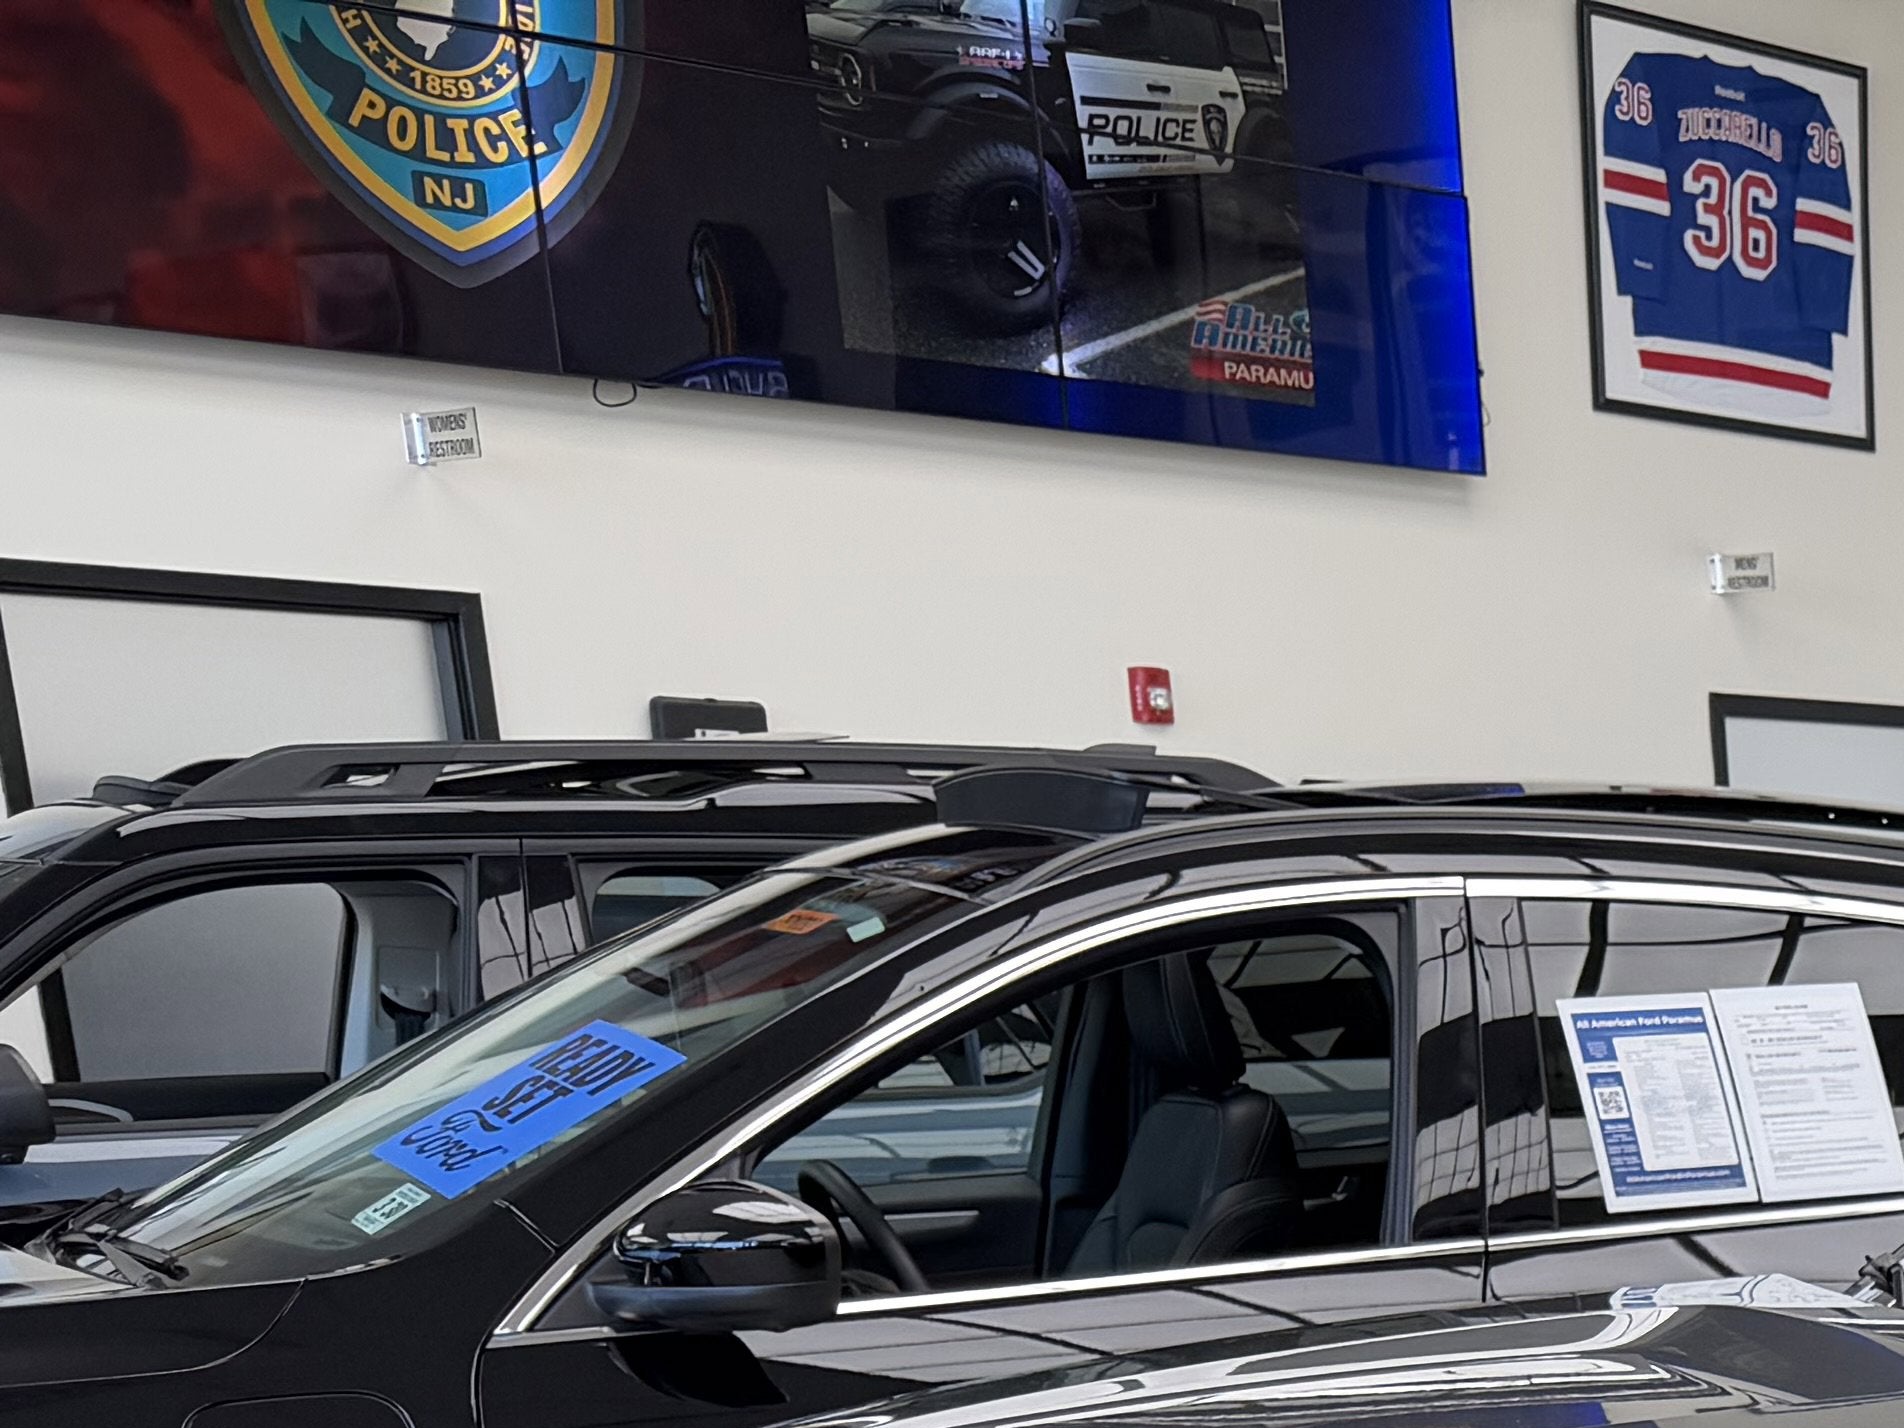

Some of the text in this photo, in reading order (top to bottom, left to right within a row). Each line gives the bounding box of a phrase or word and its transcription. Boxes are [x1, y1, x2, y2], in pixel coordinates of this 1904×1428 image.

[410, 70, 475, 98] 1859
[1614, 78, 1653, 126] 36
[348, 88, 547, 163] POLICE
[1087, 113, 1198, 147] POLICE
[1678, 107, 1782, 162] ZUCCARELLO
[1806, 122, 1843, 169] 36
[423, 176, 475, 209] NJ
[1683, 158, 1777, 281] 36
[1224, 361, 1314, 390] PARAMU
[428, 437, 475, 458] RESTROOM
[529, 1033, 656, 1096] READY
[482, 1075, 573, 1124] SET
